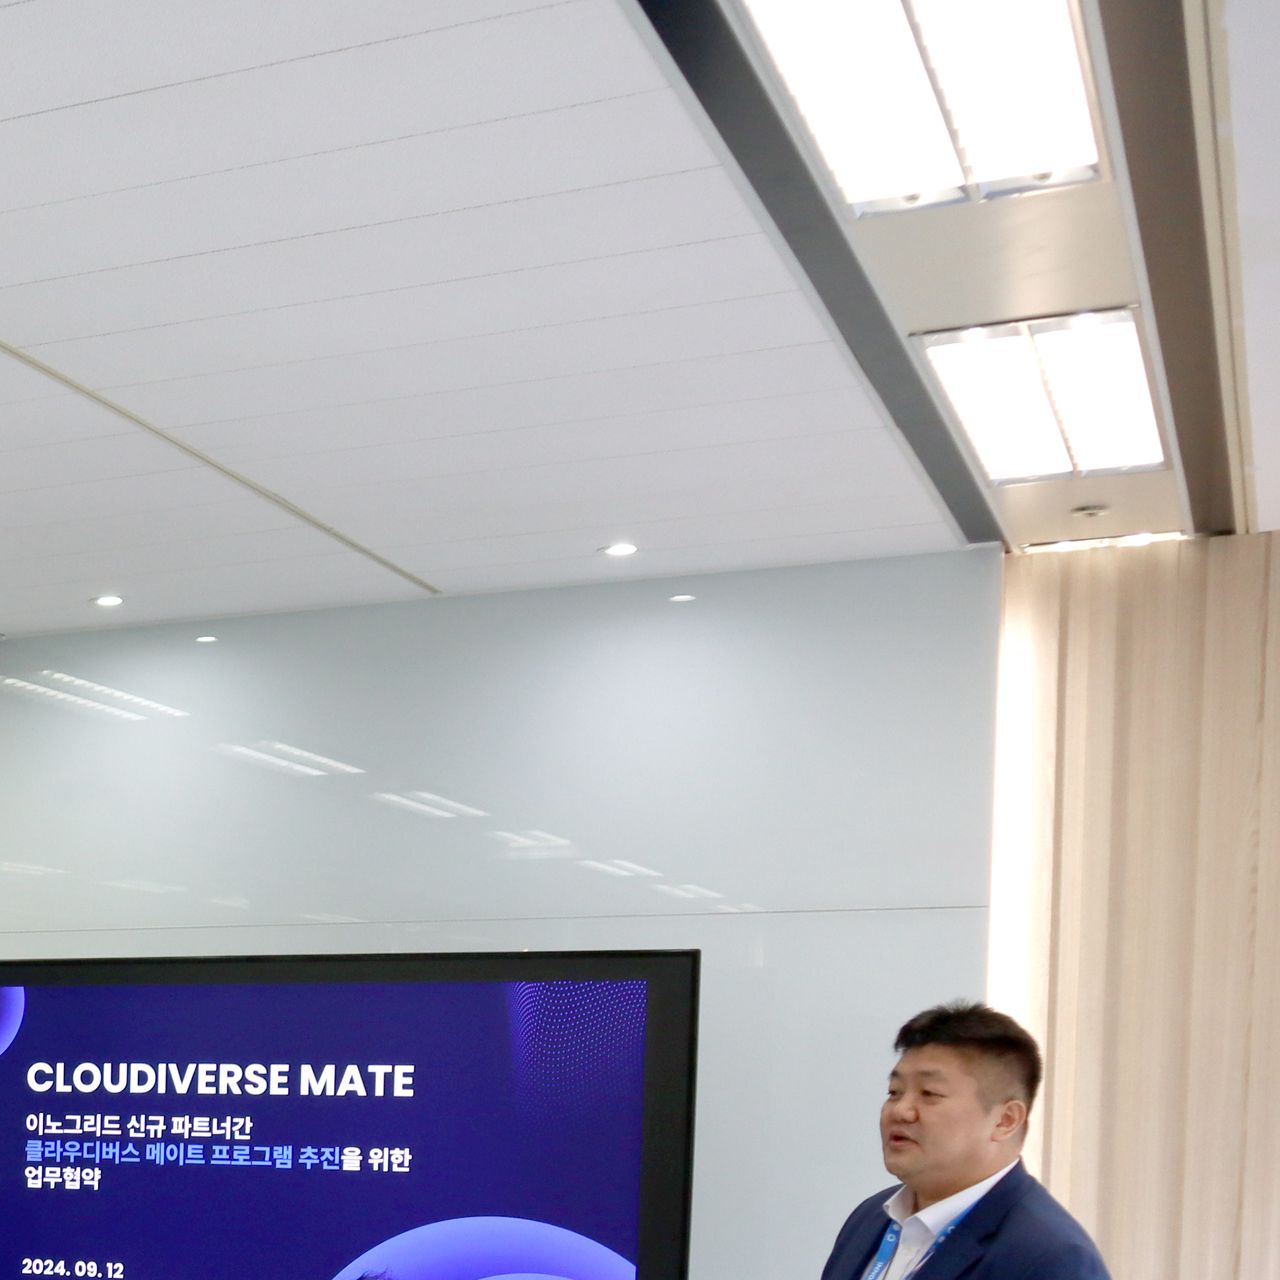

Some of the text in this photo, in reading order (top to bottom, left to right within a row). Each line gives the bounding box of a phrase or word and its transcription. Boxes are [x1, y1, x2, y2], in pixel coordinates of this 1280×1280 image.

[26, 1062, 415, 1097] CLOUDIVERSE MATE
[26, 1112, 253, 1140] 이노그리드 신규 파트너간
[25, 1139, 412, 1173] 클라우디버스 메이트 프로그램 추진을 위한
[24, 1165, 102, 1190] 업무협약
[21, 1258, 124, 1279] 2024. 09. 12
